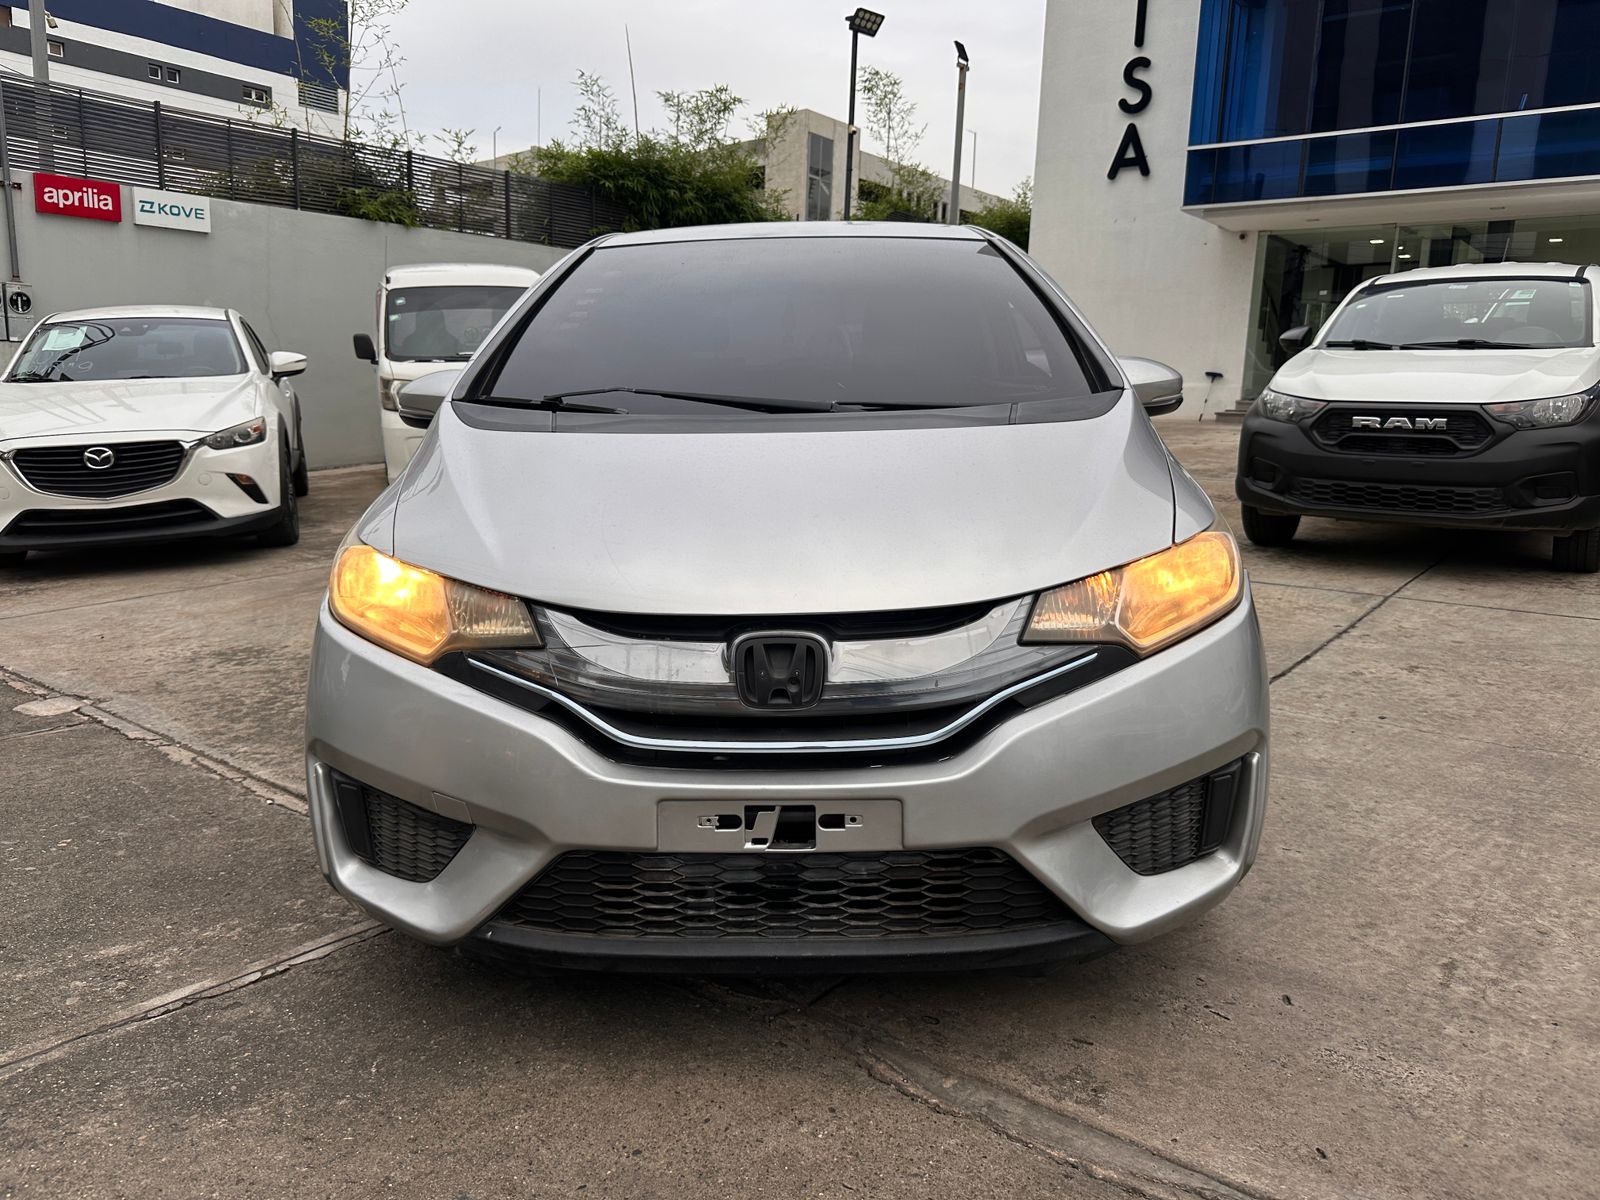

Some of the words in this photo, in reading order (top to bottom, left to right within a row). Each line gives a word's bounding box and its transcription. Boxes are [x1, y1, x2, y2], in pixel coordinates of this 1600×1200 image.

[43, 186, 113, 211] aprilia
[157, 202, 206, 220] KOVE
[1351, 416, 1448, 430] RAM
